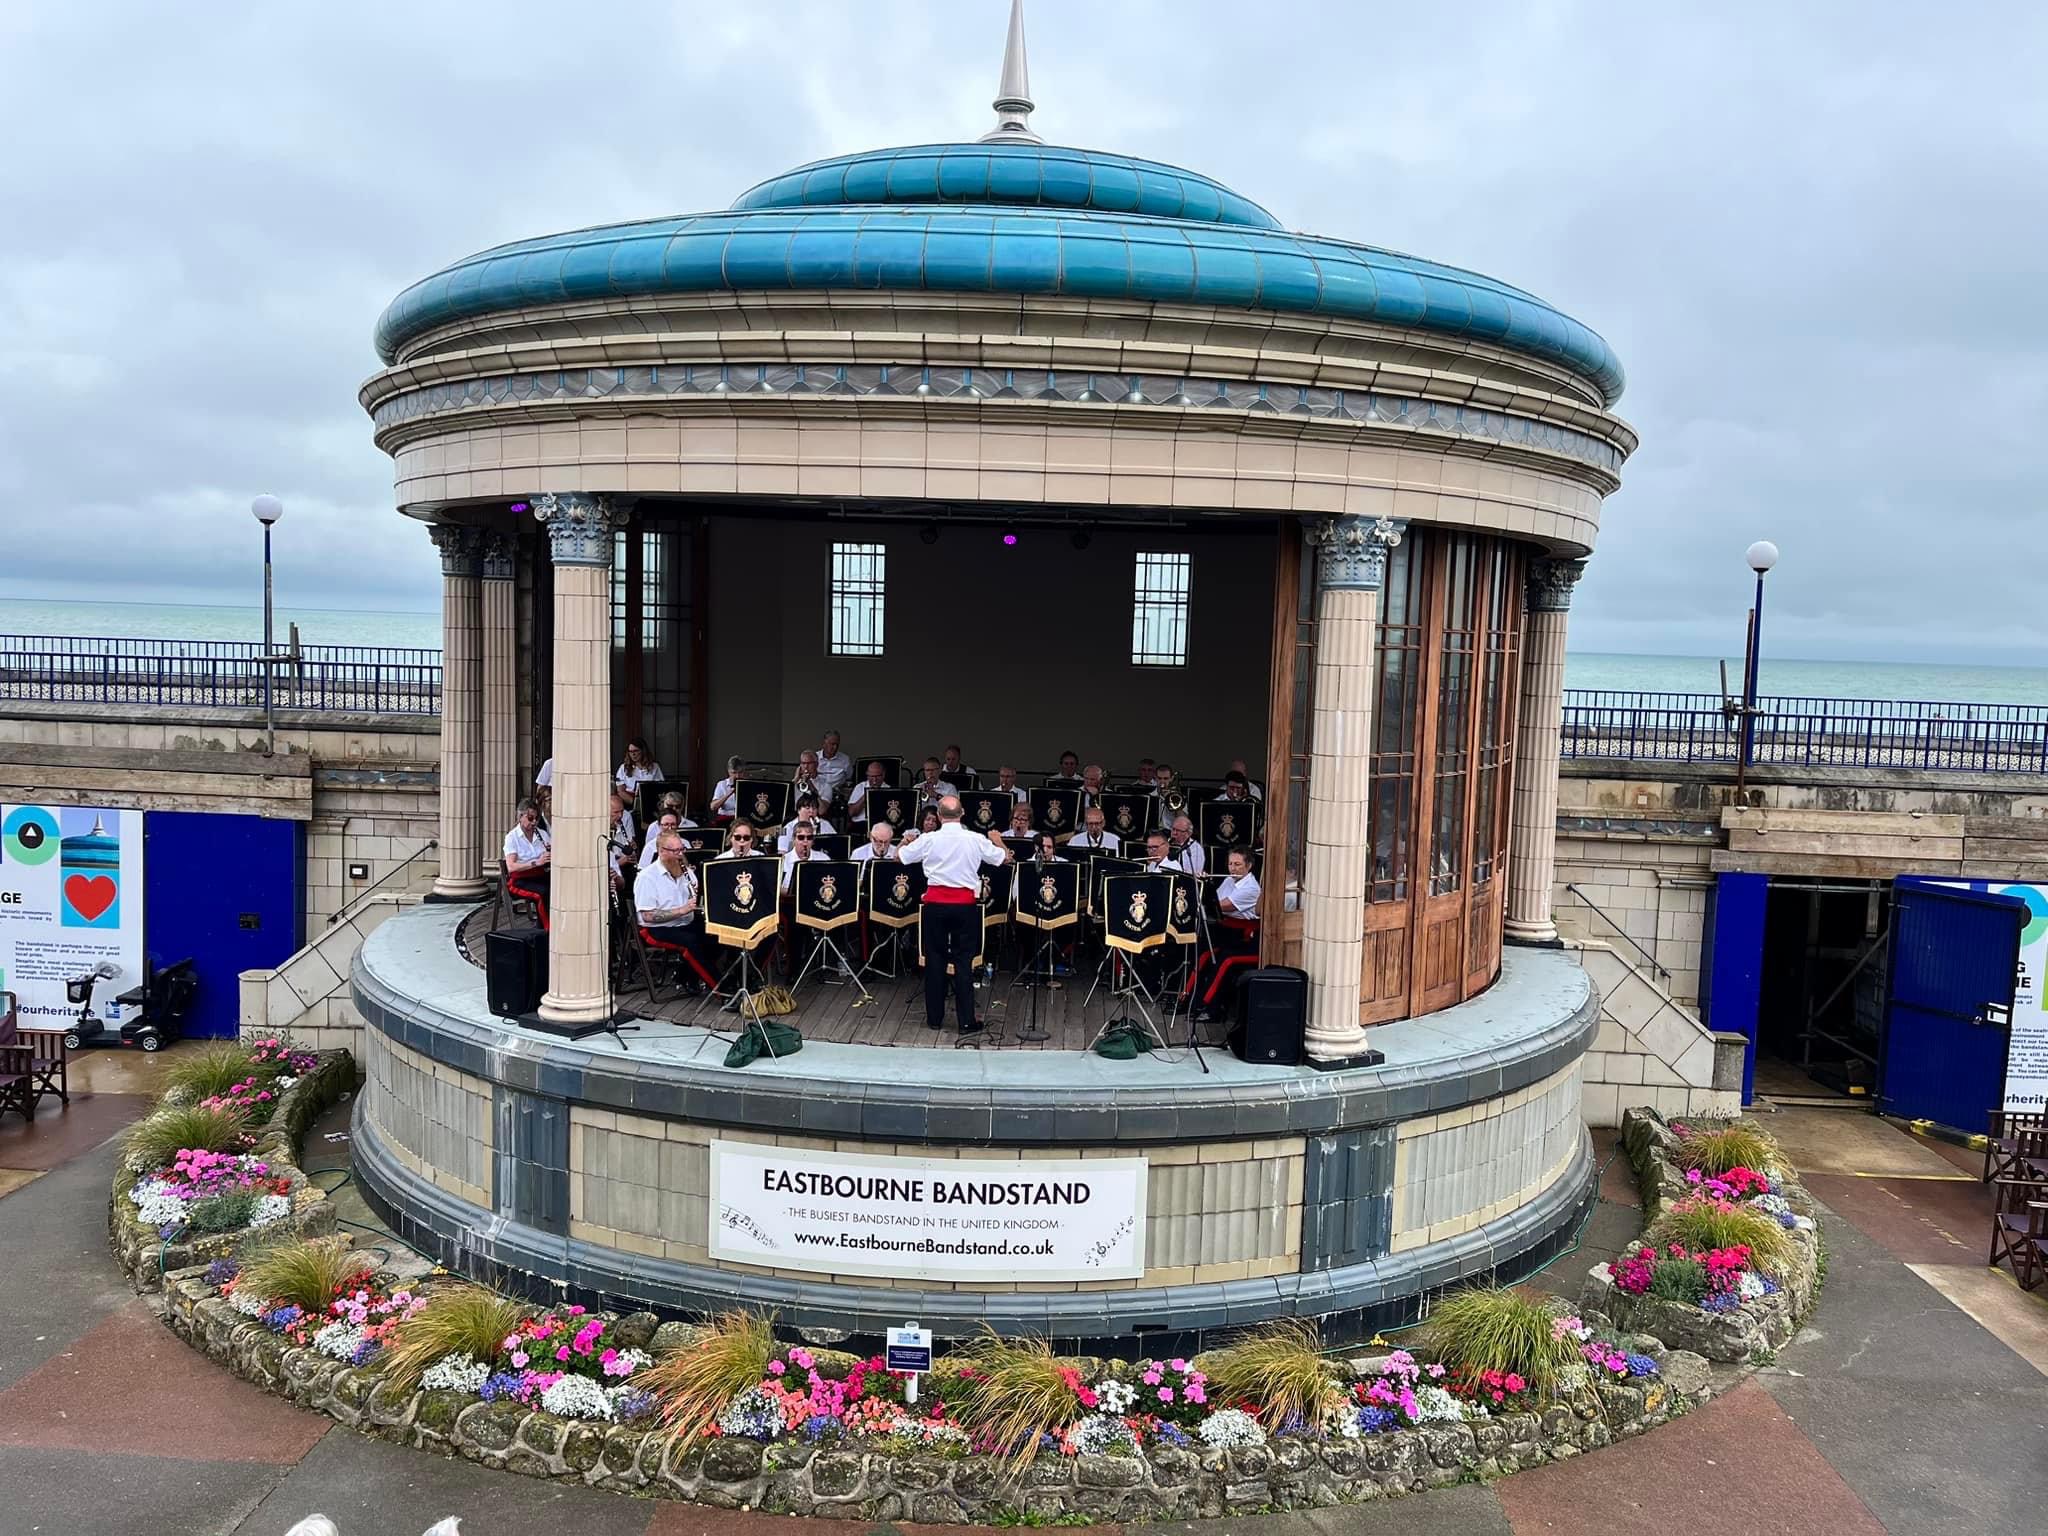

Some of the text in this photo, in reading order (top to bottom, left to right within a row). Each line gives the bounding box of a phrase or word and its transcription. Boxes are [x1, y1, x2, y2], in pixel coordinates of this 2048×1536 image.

[1, 892, 22, 904] GE
[763, 1168, 1090, 1205] EASTBOURNE BANDSTAND
[789, 1207, 1059, 1230] THE BUSIEST BANDSTAND IN THE UNITED KINGDOM
[794, 1232, 1054, 1256] www.EastbourneBandstand.co.uk
